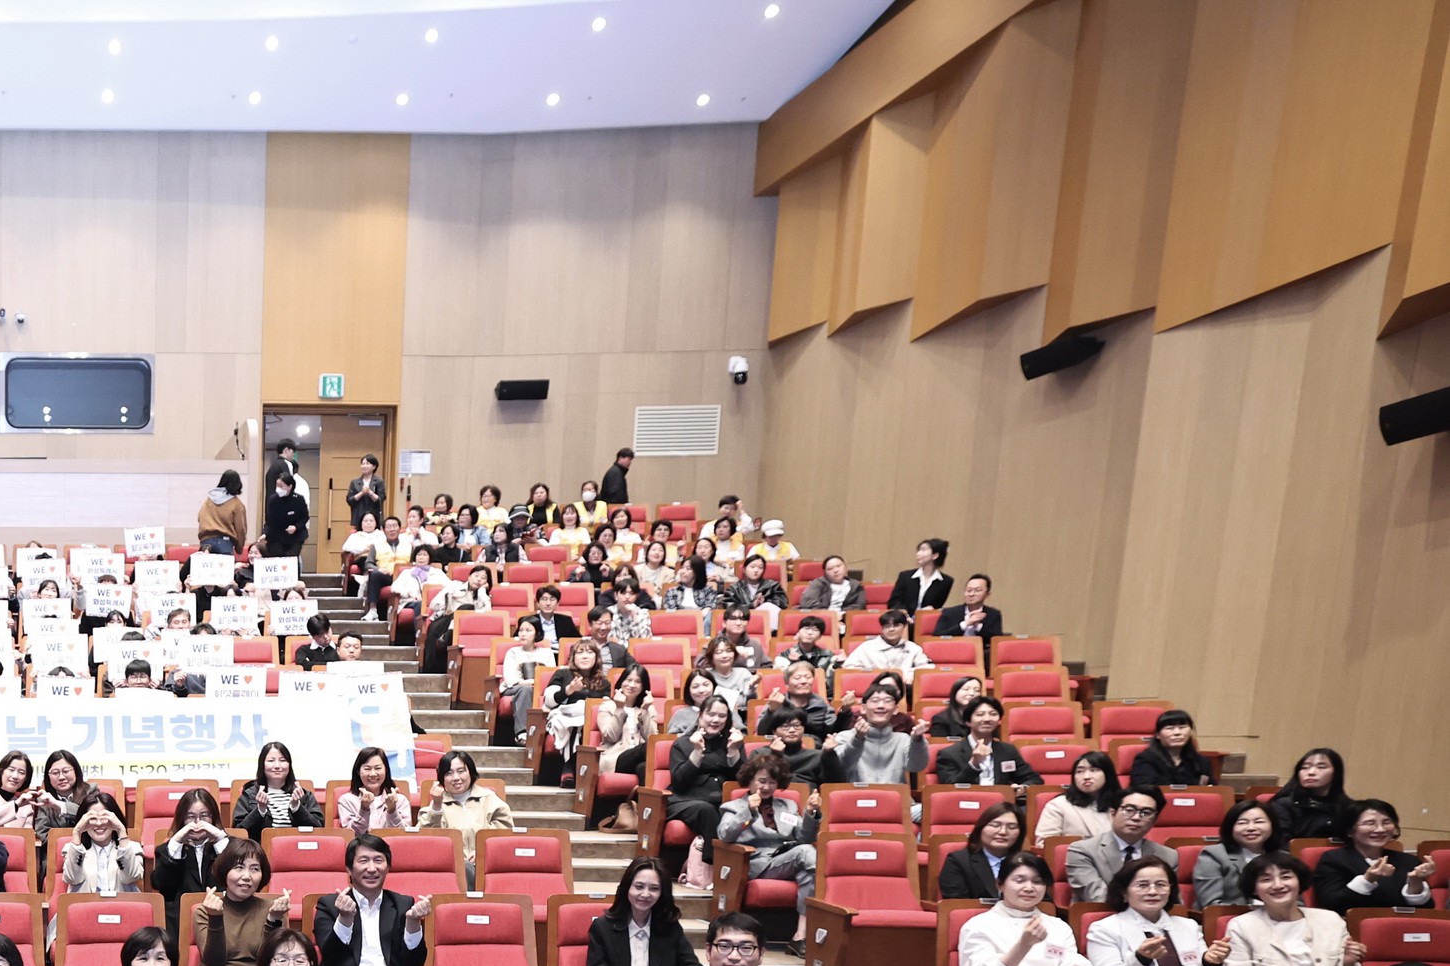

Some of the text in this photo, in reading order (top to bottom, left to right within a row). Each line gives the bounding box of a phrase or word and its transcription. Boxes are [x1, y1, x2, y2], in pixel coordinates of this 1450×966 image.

[134, 533, 147, 541] WE
[91, 558, 104, 566] WE
[201, 561, 215, 569] WE
[33, 566, 46, 574] WE
[146, 567, 160, 576] WE
[265, 564, 278, 573] WE
[97, 589, 111, 597] WE
[161, 598, 176, 607] WE
[34, 604, 48, 612] WE
[223, 604, 237, 612] WE
[282, 606, 296, 614] WE
[40, 624, 55, 632] WE
[46, 643, 63, 652] WE
[192, 644, 209, 653] WE
[122, 650, 140, 659] WE
[220, 674, 240, 684] WE
[294, 681, 313, 691] WE
[358, 683, 377, 694] WE
[51, 686, 70, 696] WE
[6, 714, 52, 755] 날
[71, 713, 269, 754] 기념행사
